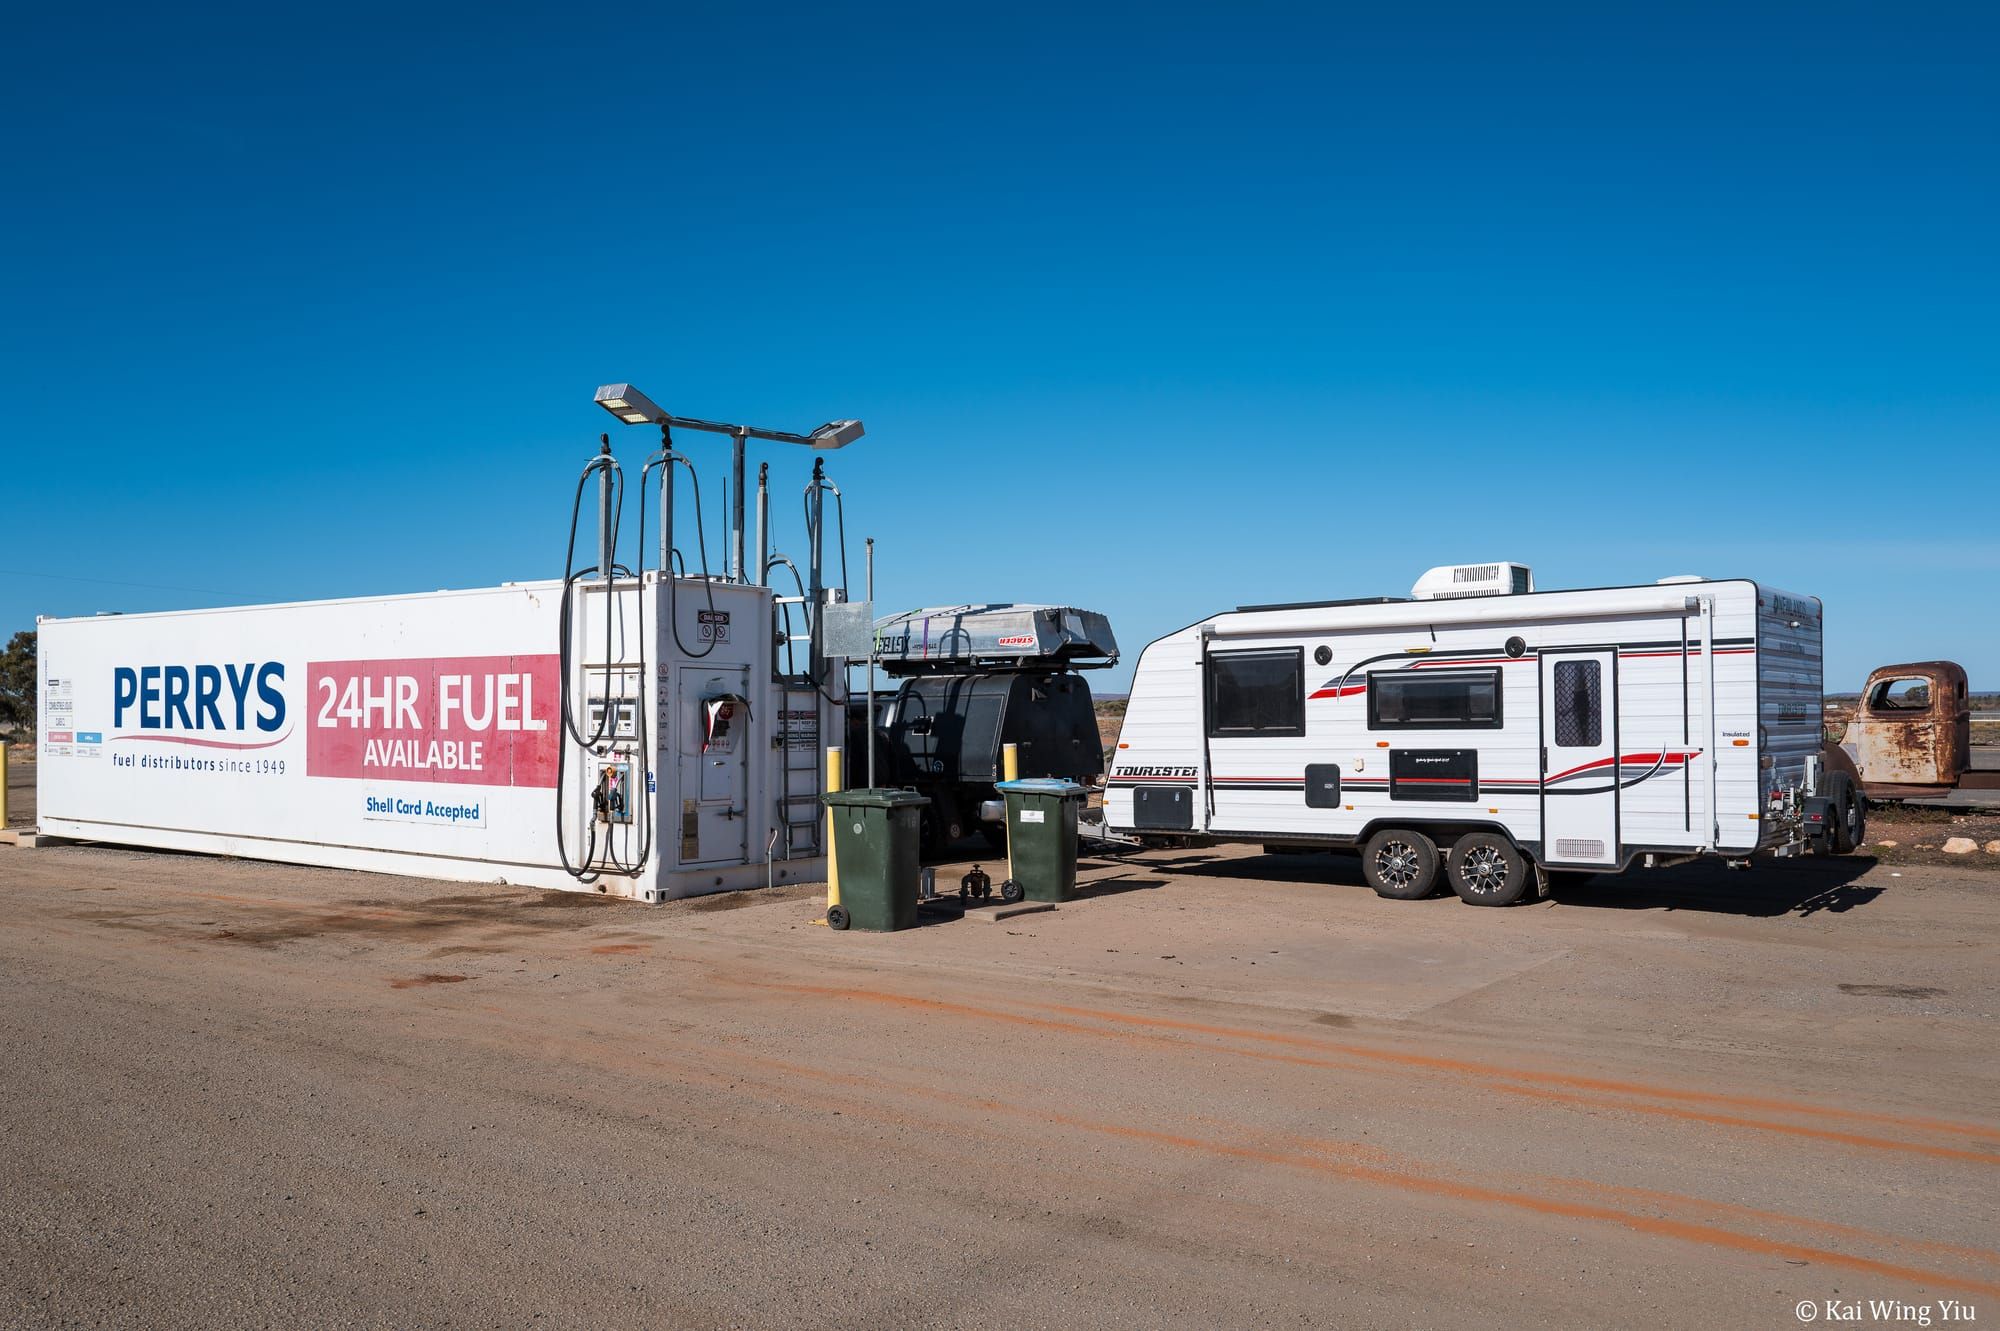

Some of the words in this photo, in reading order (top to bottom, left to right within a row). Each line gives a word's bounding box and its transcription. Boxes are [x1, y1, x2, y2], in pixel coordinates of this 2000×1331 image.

[999, 637, 1034, 646] STACER
[114, 661, 286, 732] PERRYS
[317, 676, 423, 729] 24HR
[439, 673, 548, 731] FUEL
[113, 753, 135, 767] fuel
[141, 754, 215, 771] distributors
[219, 758, 251, 773] since
[256, 759, 286, 775] 1949
[363, 739, 483, 771] AVAILABLE
[366, 797, 393, 813] Shell
[396, 799, 422, 816] Card
[425, 801, 479, 822] Accepted
